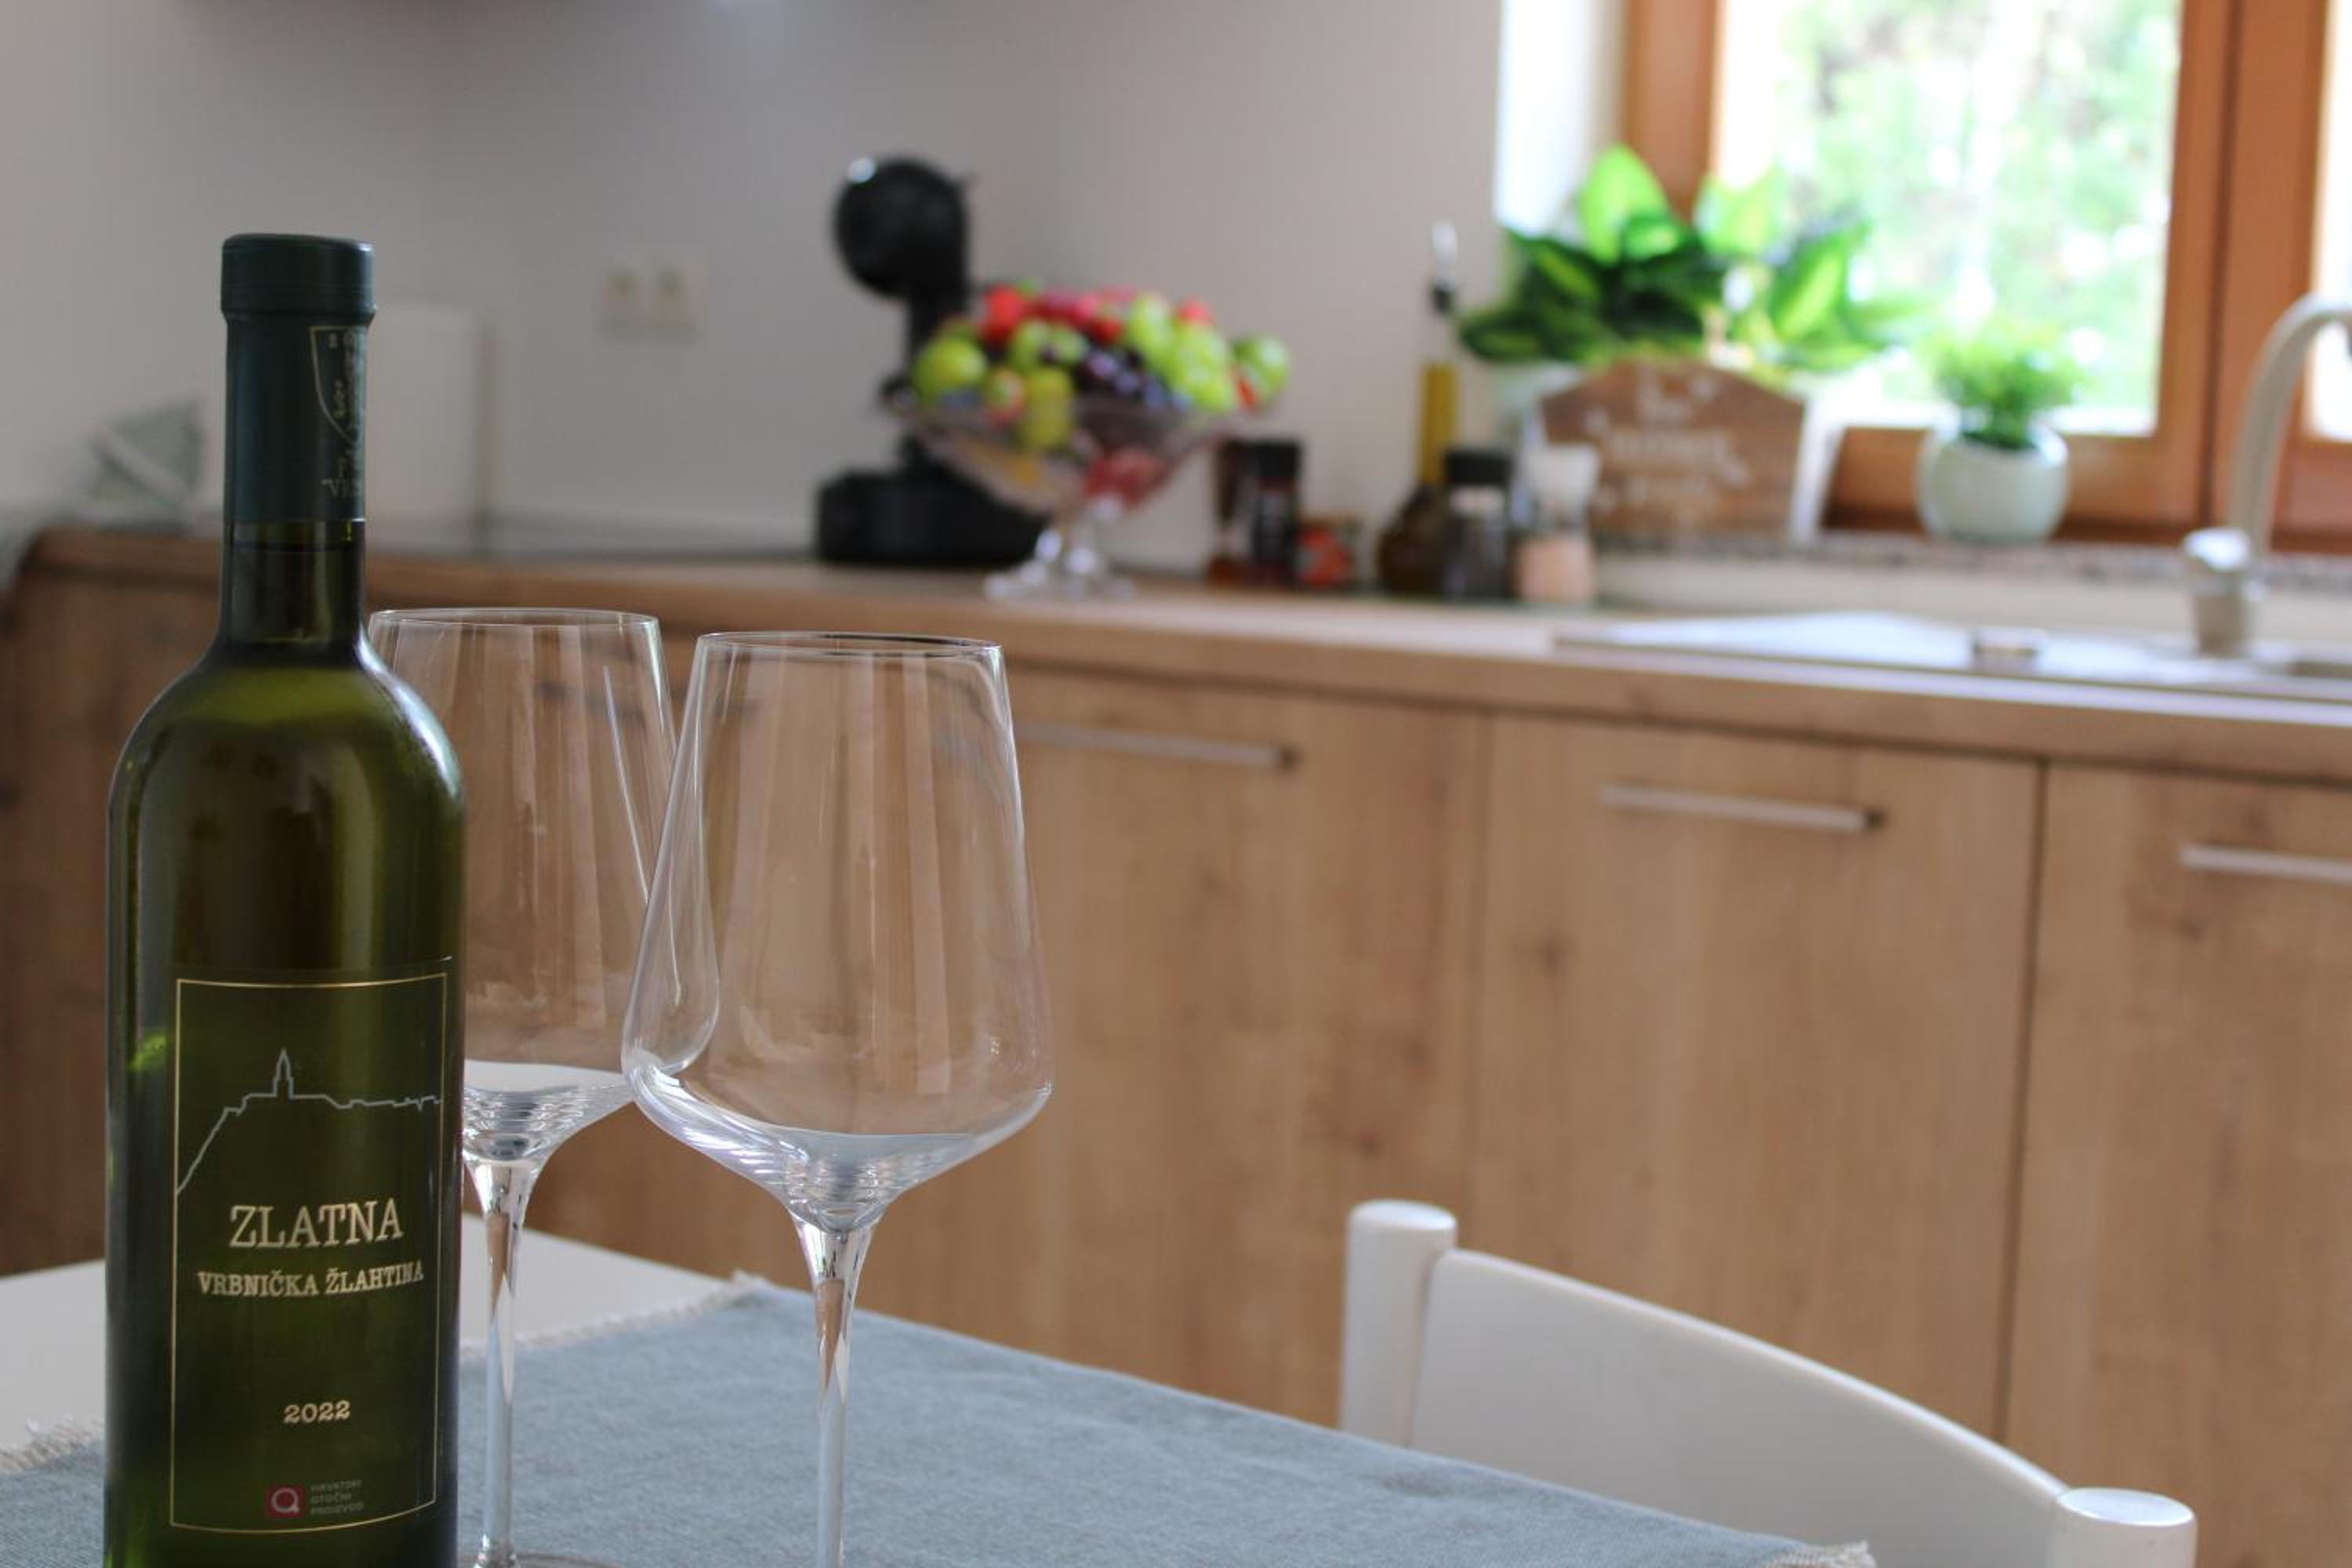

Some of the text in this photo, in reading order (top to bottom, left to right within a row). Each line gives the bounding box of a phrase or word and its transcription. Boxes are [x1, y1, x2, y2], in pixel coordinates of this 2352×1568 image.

[229, 1197, 405, 1248] ZLATNA
[198, 1260, 424, 1298] VRBNIČKA ŽLAHTINA
[283, 1399, 350, 1424] 2022
